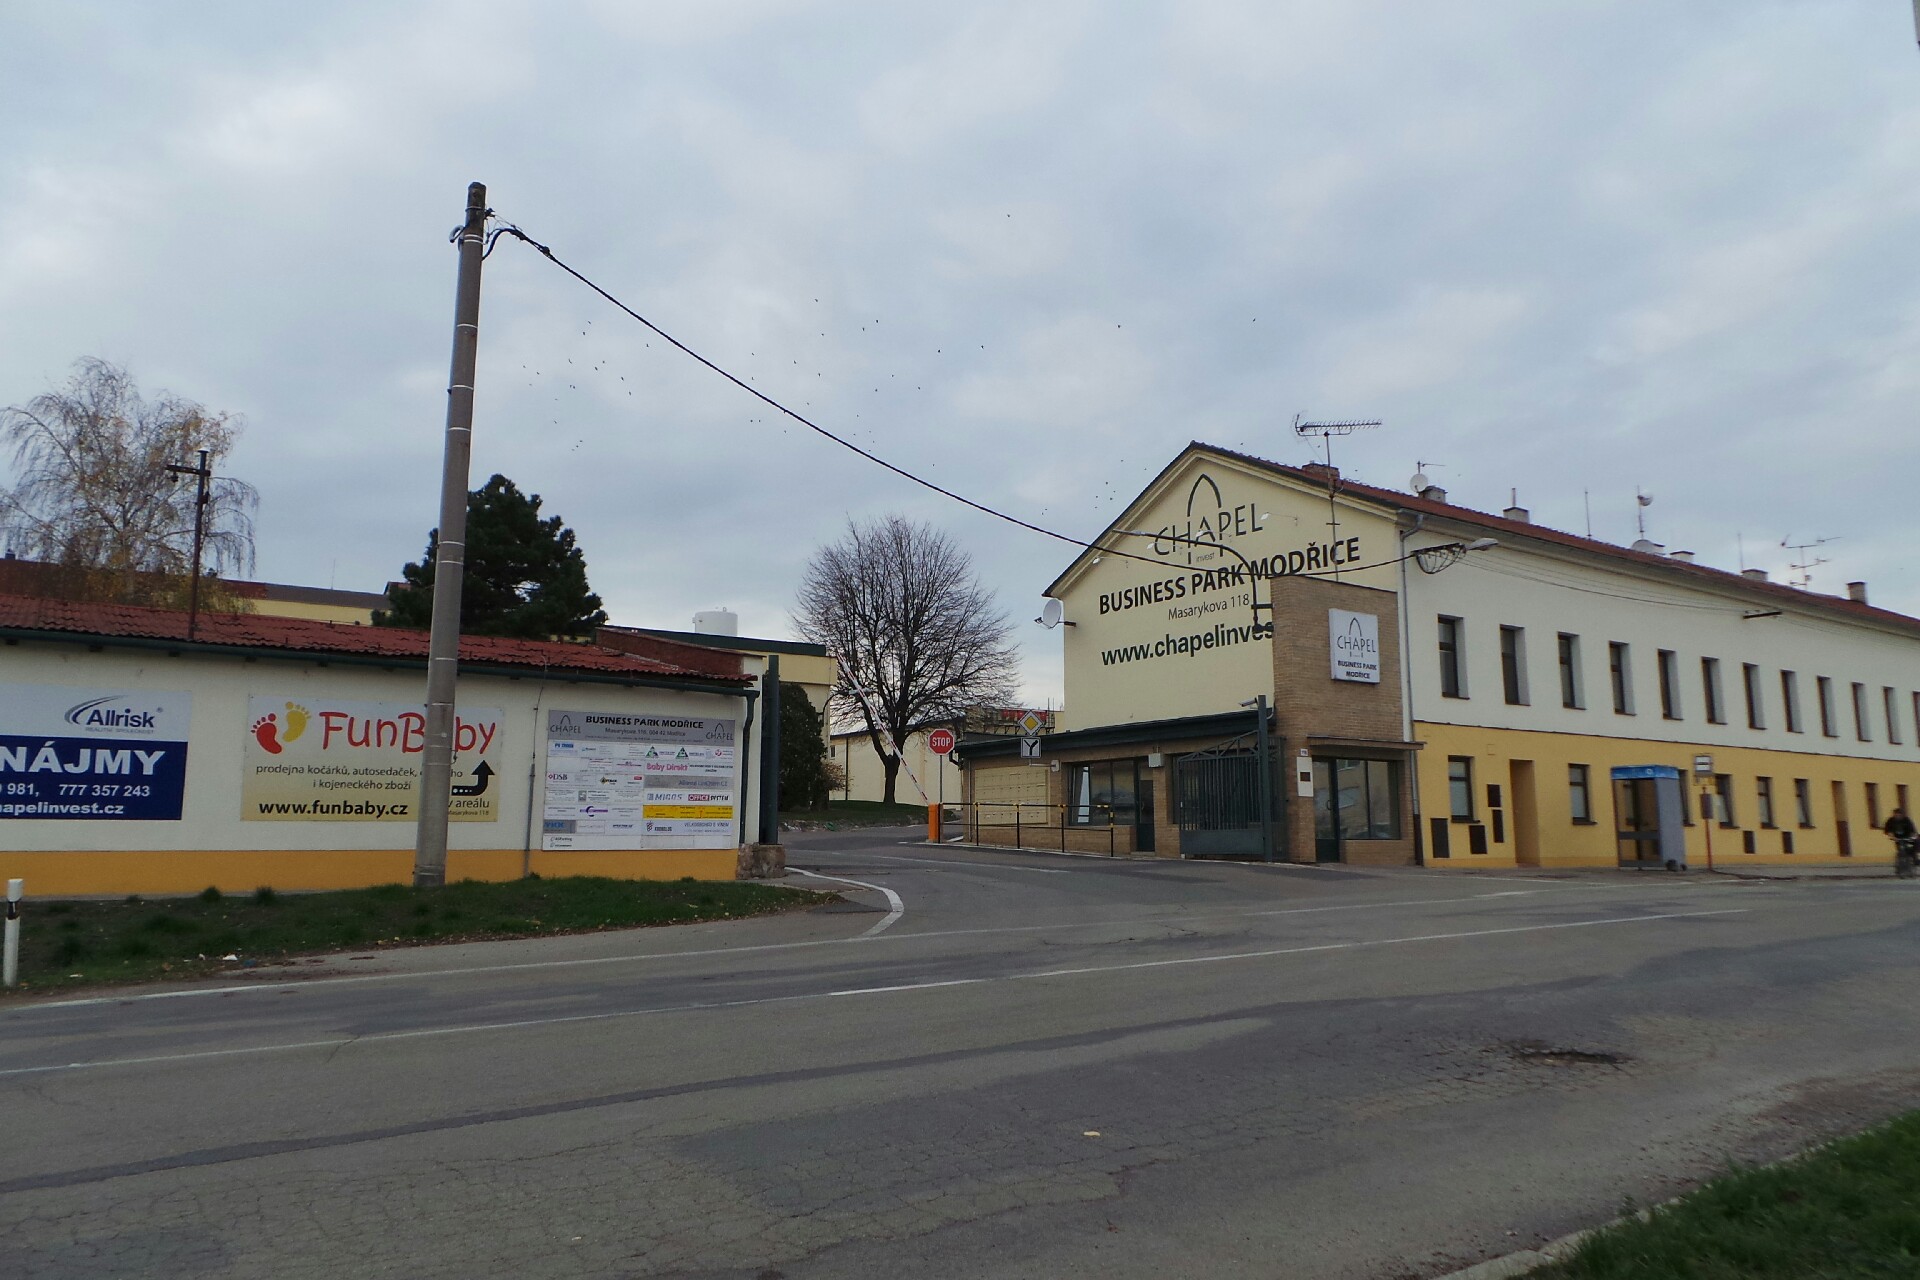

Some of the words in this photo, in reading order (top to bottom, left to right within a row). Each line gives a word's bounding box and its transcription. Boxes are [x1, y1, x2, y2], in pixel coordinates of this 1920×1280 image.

[1154, 503, 1263, 561] CHAPEL
[1099, 575, 1186, 615] BUSINESS
[1192, 562, 1246, 596] PARK
[1250, 536, 1361, 582] MODŘICE
[1168, 599, 1228, 621] Masarykova
[1231, 593, 1250, 609] 118
[1337, 635, 1376, 653] CHAPEL
[1337, 660, 1362, 669] BUSINESS
[87, 708, 155, 728] Allrisk
[319, 711, 496, 755] FunBby
[550, 724, 582, 735] CHAPEL
[586, 715, 632, 727] BUSINESS
[634, 718, 659, 727] PARK
[661, 718, 704, 729] MODŘICE
[705, 731, 735, 741] CHAPEL
[932, 737, 951, 747] STOP
[256, 764, 305, 776] prodejna
[352, 766, 417, 778] autosedaček,
[553, 773, 568, 781] DSB
[7, 783, 39, 797] 981,
[59, 784, 87, 796] 777
[92, 784, 118, 797] 357
[124, 785, 150, 797] 243
[318, 779, 383, 791] kojeneckého
[385, 779, 412, 791] zboží
[259, 800, 408, 818] www.funbaby.cz
[455, 798, 490, 808] areálu
